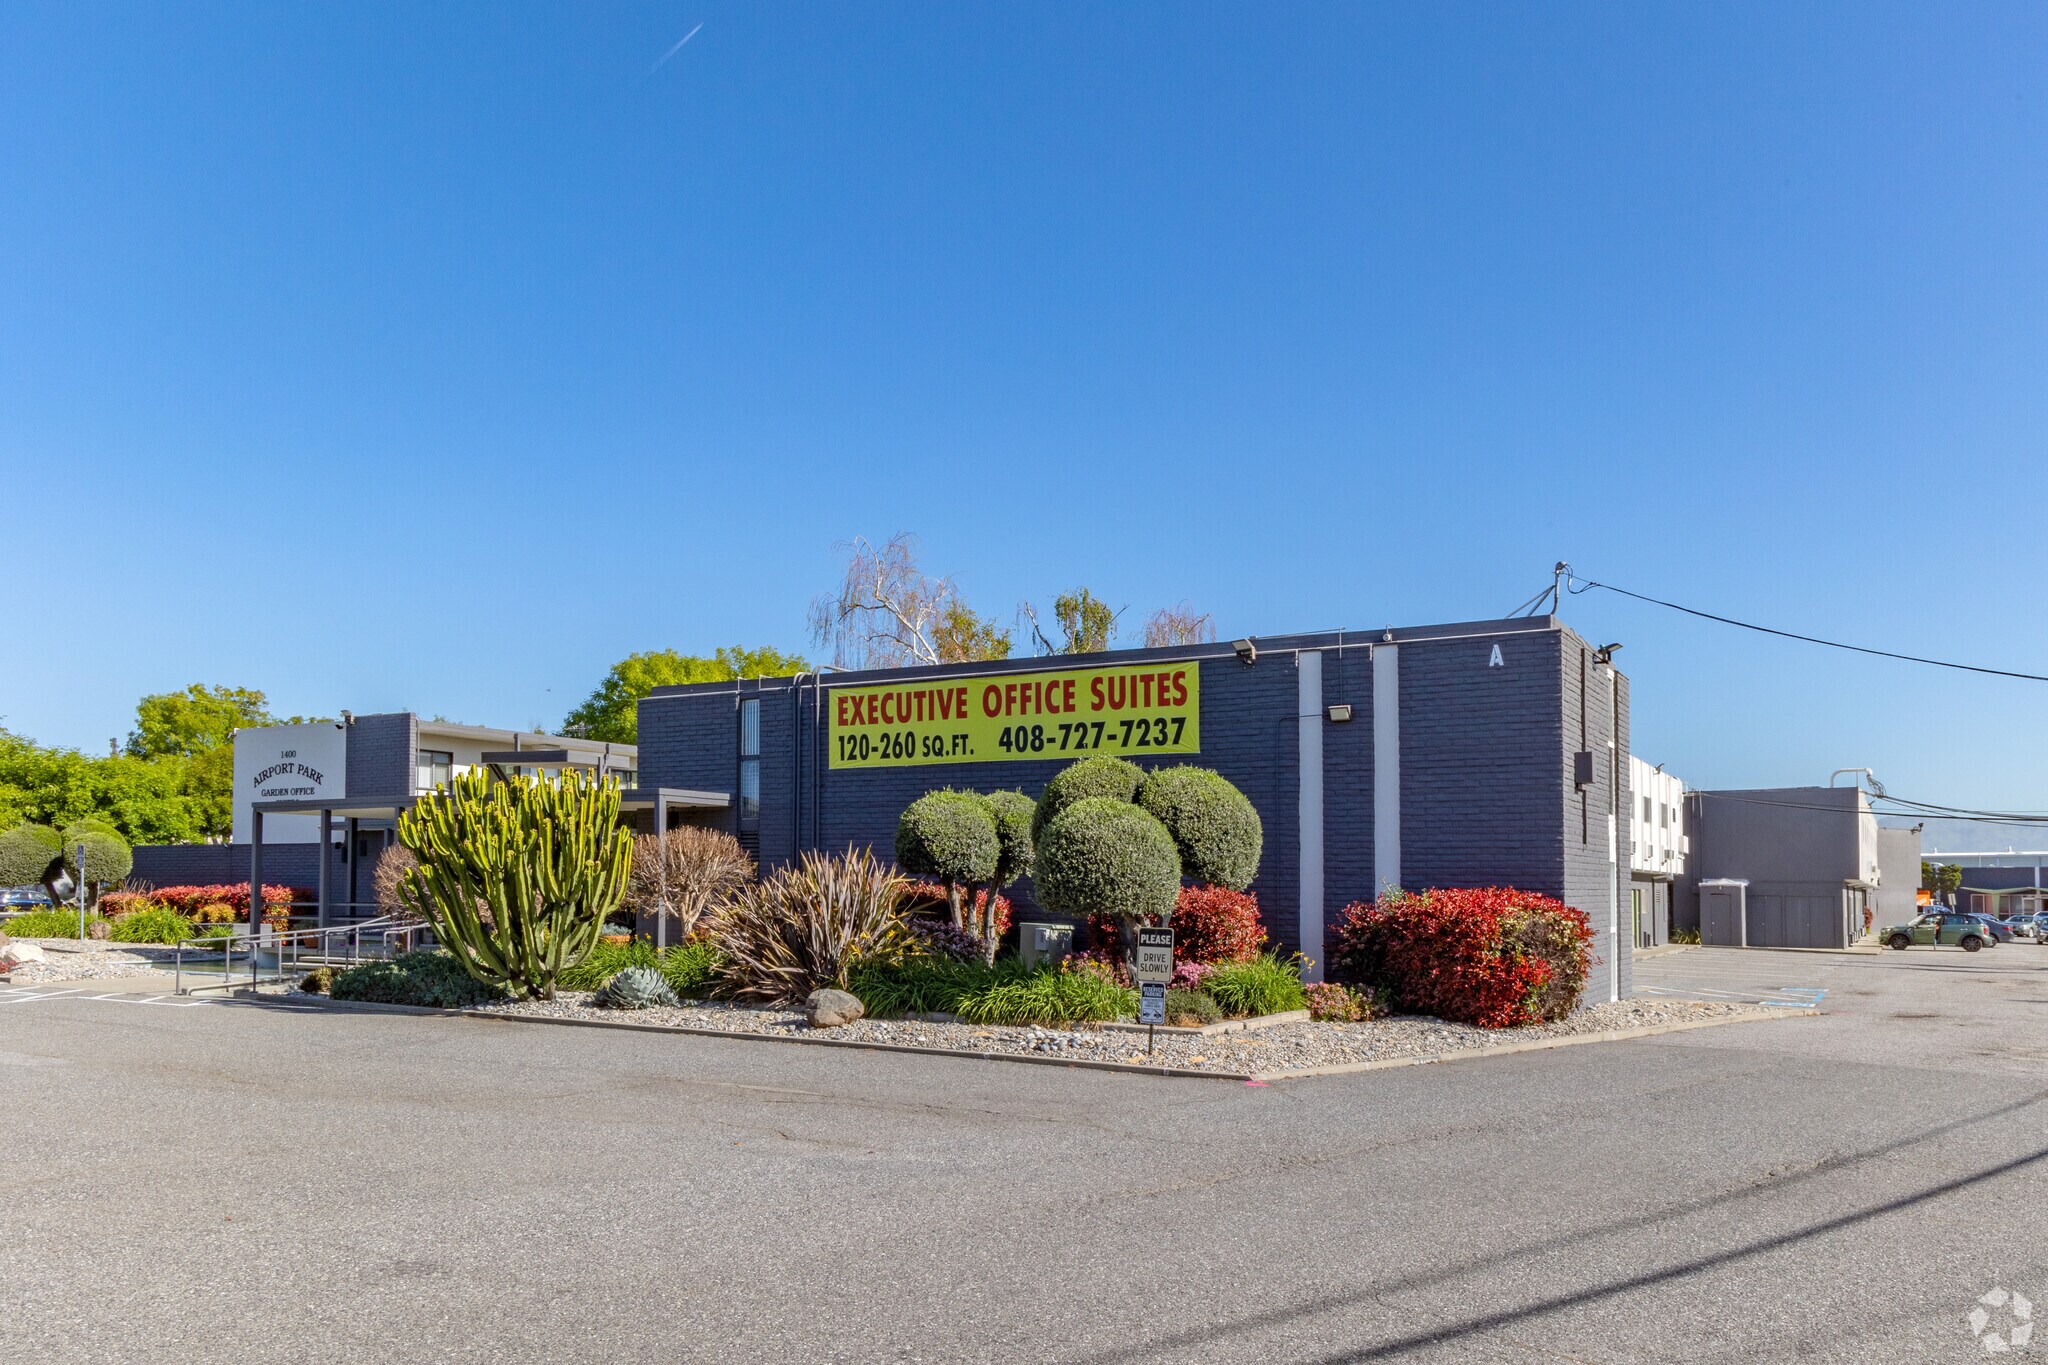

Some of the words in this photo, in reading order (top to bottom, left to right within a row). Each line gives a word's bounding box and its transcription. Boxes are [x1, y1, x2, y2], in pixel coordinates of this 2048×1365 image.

[1489, 644, 1504, 667] A
[837, 687, 968, 726] EXECUTIVE
[982, 679, 1076, 718] OFFICE
[1090, 671, 1188, 711] SUITES
[838, 731, 916, 761] 120-260
[922, 733, 975, 758] SQ.FT.
[998, 717, 1187, 753] 408-727-7237
[281, 750, 296, 758] 1400
[253, 763, 294, 788] AIRPORT
[297, 764, 324, 786] PARK
[261, 788, 289, 797] GARDEN
[290, 787, 315, 796] OFFICE
[1141, 934, 1171, 944] PLEASE
[1144, 953, 1166, 962] DRIVE
[1140, 963, 1169, 973] SLOWLY
